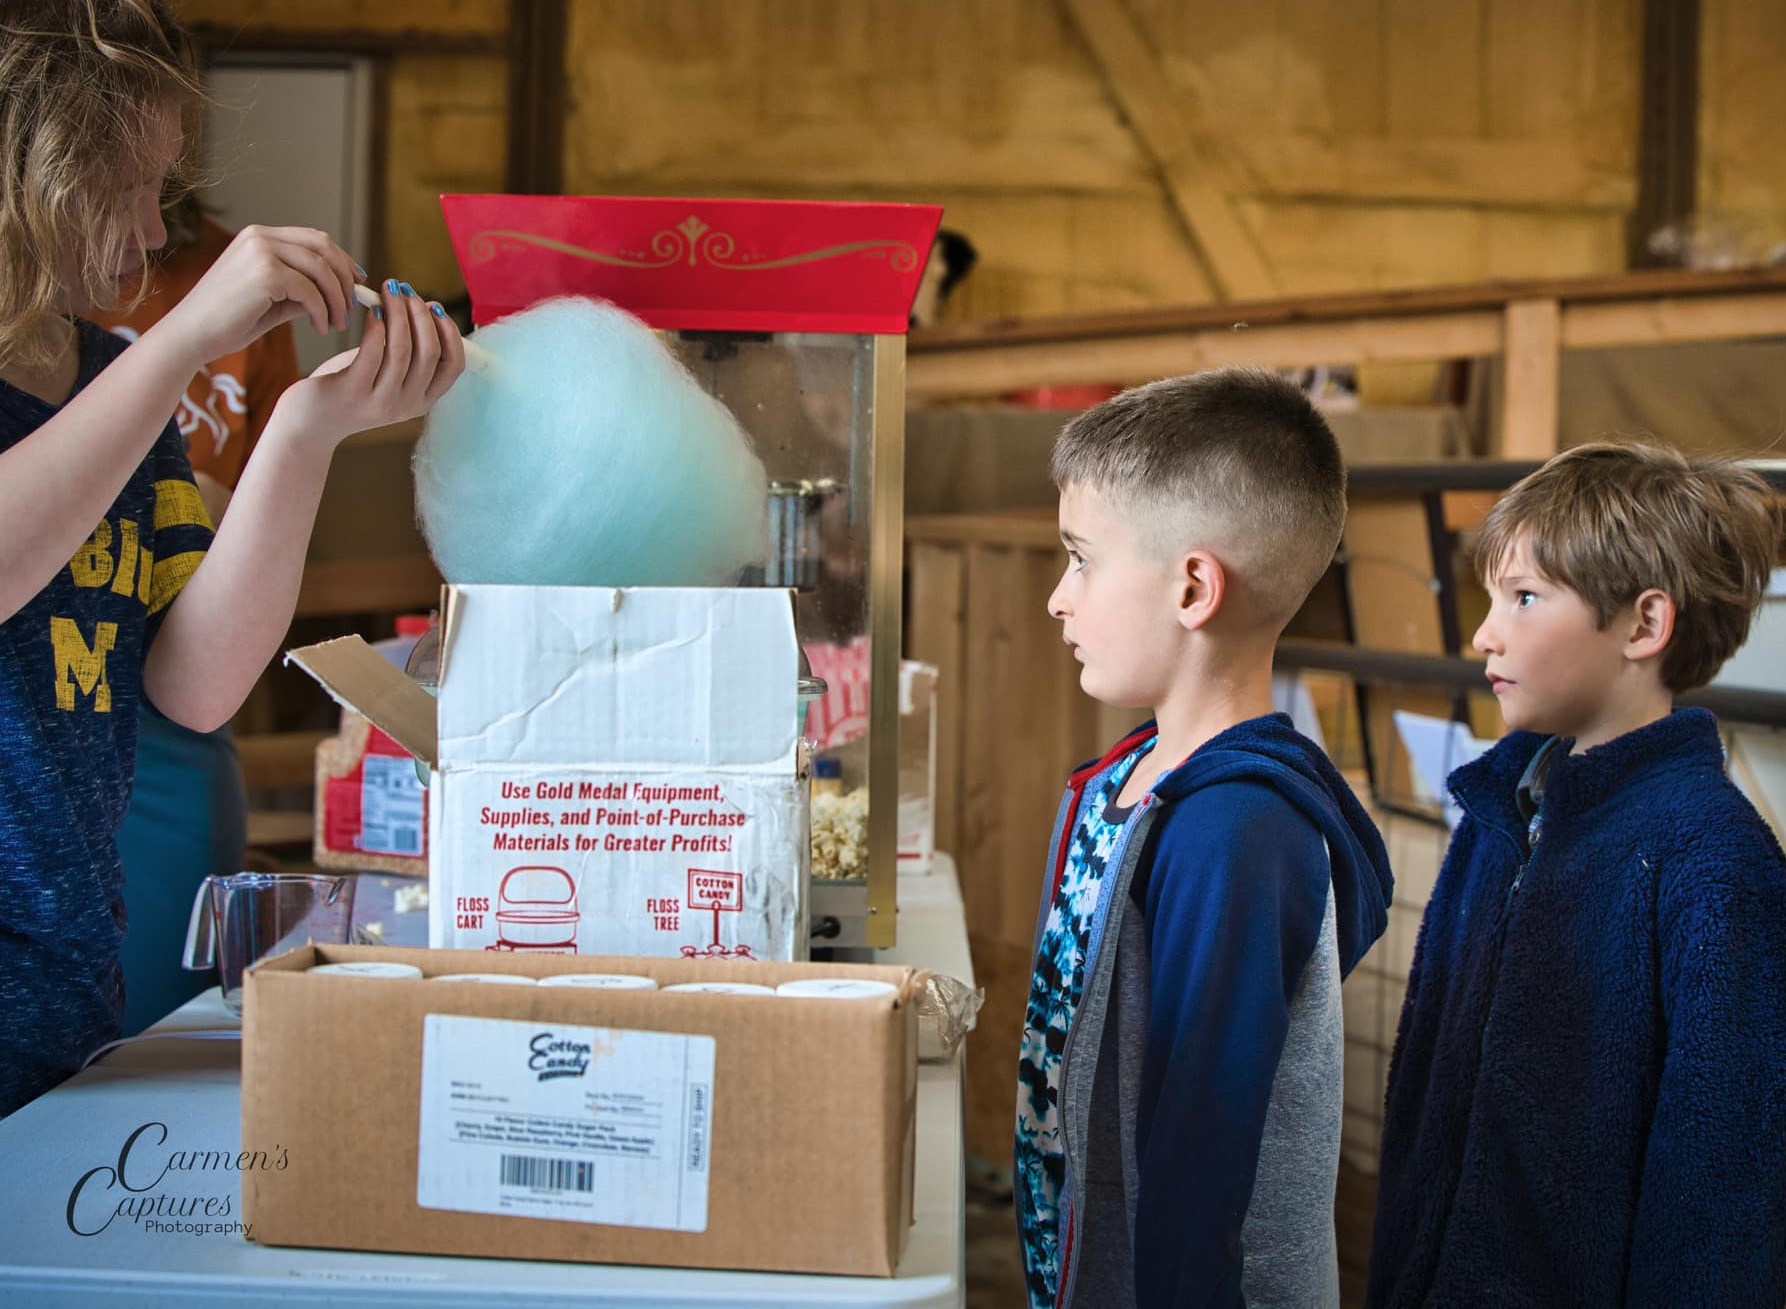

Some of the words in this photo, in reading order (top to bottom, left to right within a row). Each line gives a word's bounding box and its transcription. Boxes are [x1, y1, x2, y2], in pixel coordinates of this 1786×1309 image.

[51, 616, 118, 712] M
[501, 781, 531, 800] Use
[536, 781, 574, 801] Gold
[578, 782, 628, 801] Medal
[633, 783, 725, 804] Equipment,
[481, 807, 555, 829] Supplies,
[560, 808, 591, 827] and
[595, 808, 747, 828] Point-of-Purchase
[493, 832, 570, 852] Materials
[575, 834, 599, 852] for
[603, 834, 666, 853] Greater
[671, 834, 733, 854] Profits!
[695, 876, 735, 891] COTTON
[698, 888, 732, 902] CANDY
[457, 897, 490, 913] FLOSS
[647, 899, 680, 914] FLOSS
[456, 914, 484, 930] CART
[654, 916, 680, 932] TREE
[528, 1032, 592, 1056] Cotton
[527, 1050, 590, 1078] Candy
